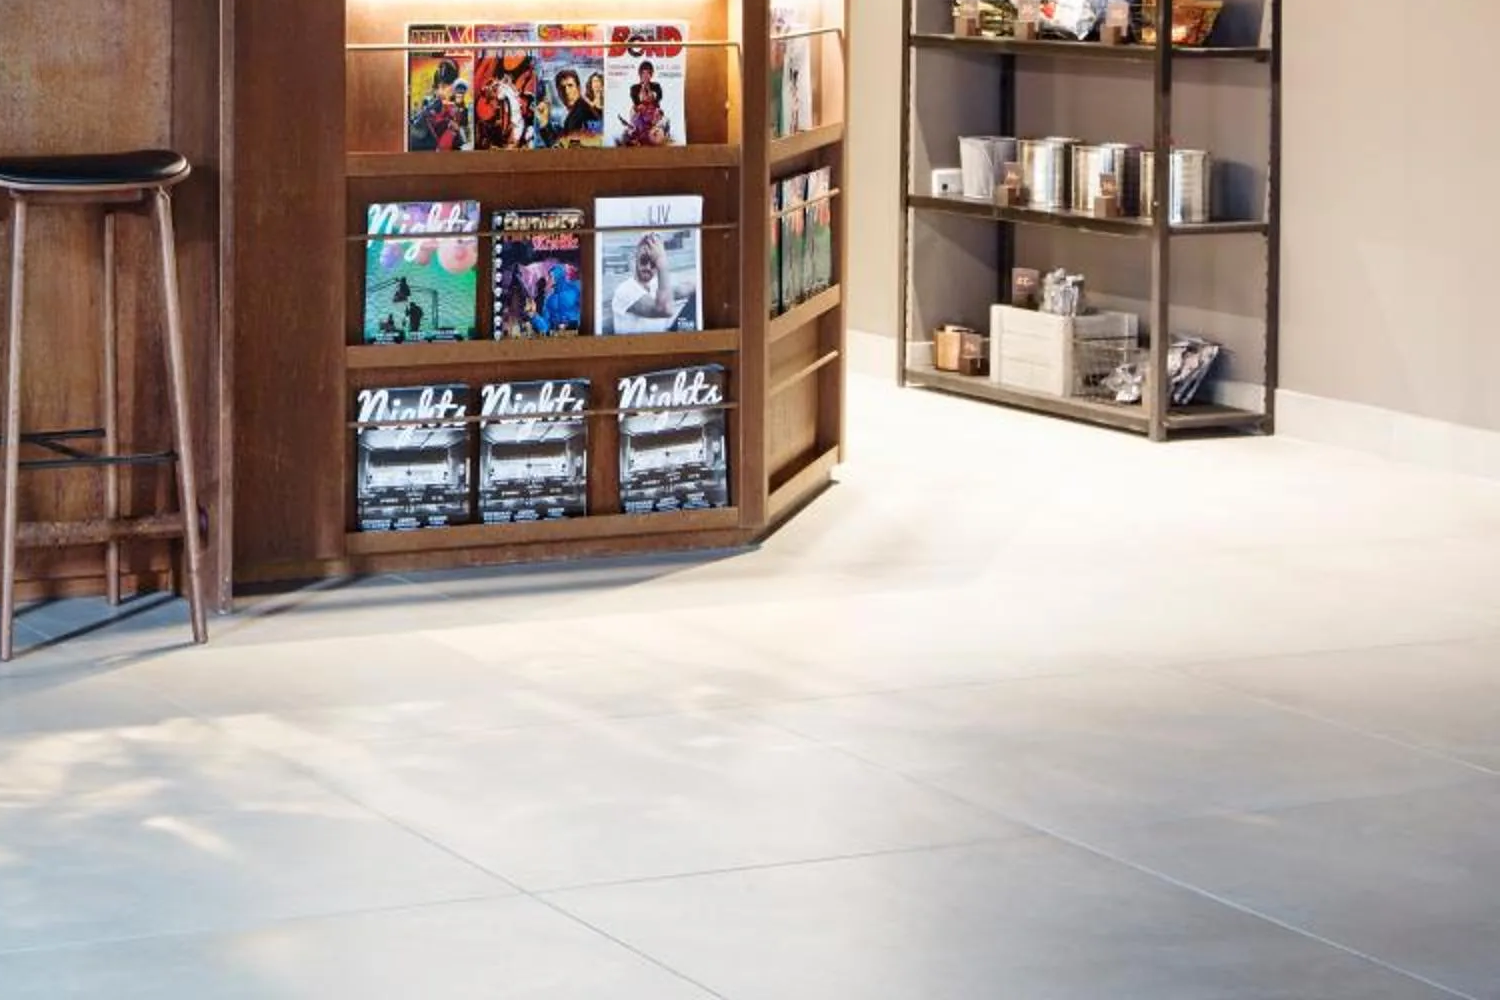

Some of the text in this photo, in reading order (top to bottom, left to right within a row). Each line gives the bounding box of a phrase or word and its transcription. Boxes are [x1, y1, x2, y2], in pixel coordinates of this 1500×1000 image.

[608, 25, 683, 58] BOND
[367, 203, 477, 262] Nights
[357, 387, 467, 450] Nights
[480, 382, 585, 443] Nights
[617, 371, 723, 433] Nights
